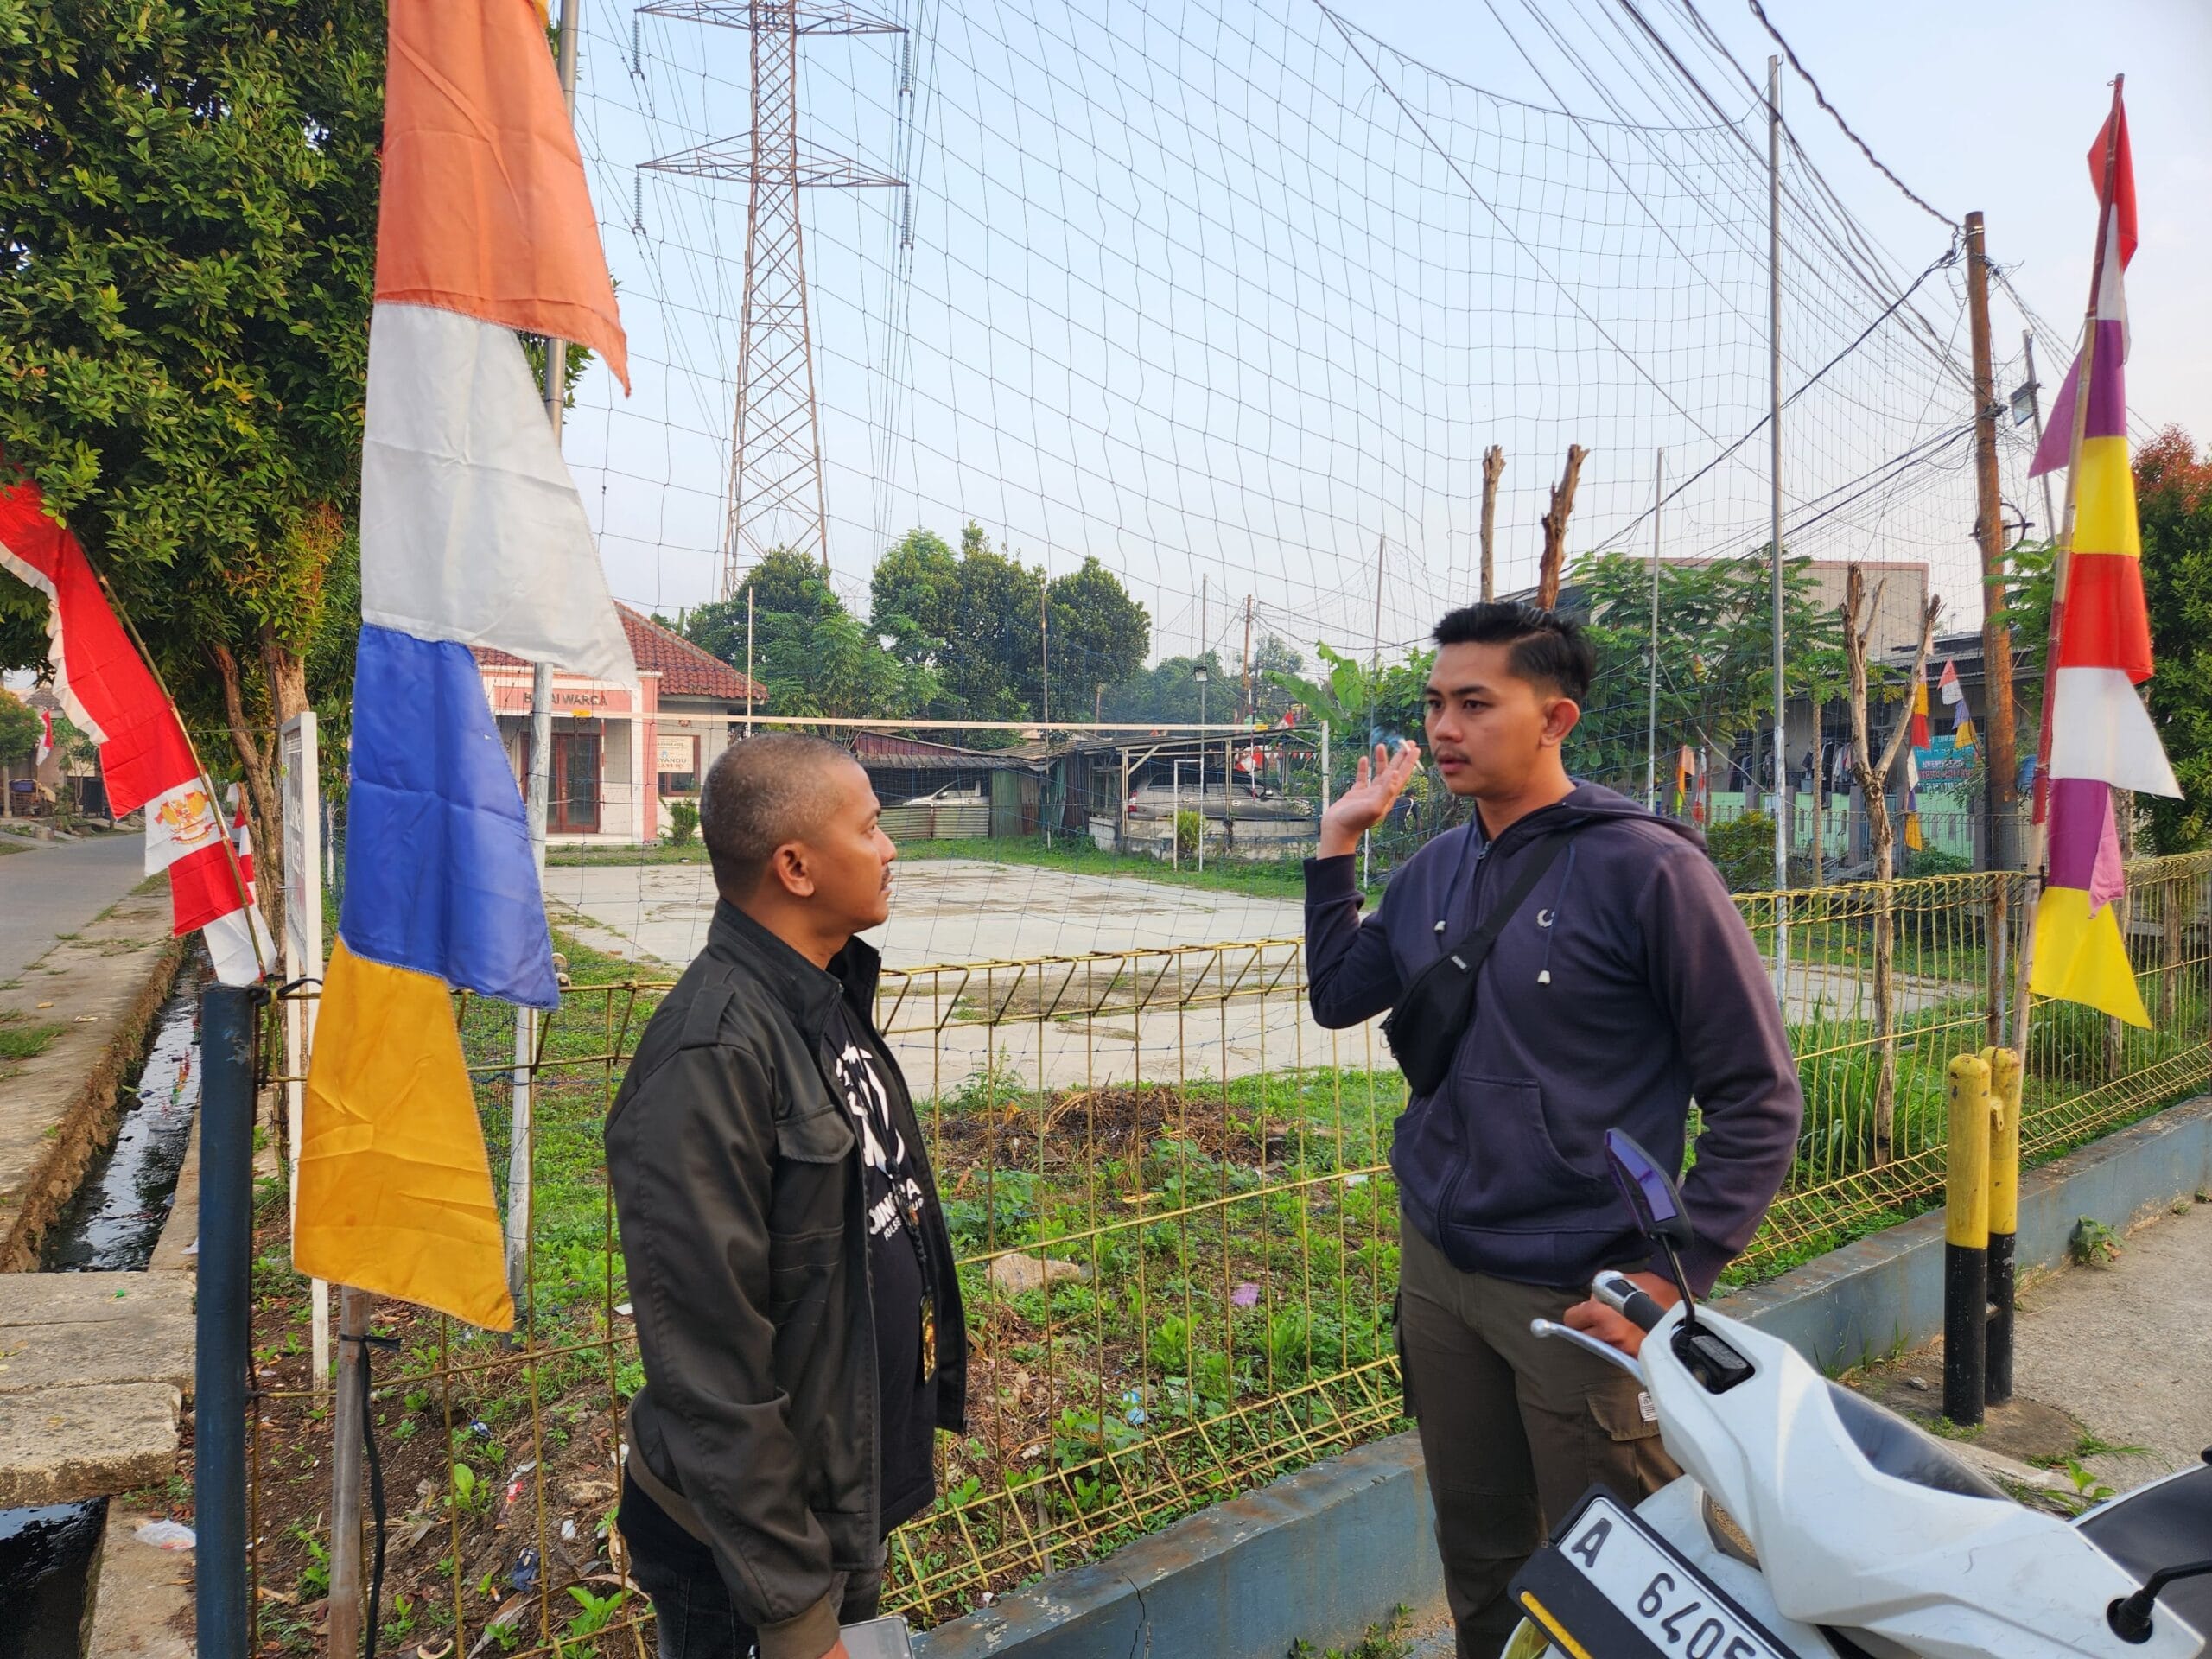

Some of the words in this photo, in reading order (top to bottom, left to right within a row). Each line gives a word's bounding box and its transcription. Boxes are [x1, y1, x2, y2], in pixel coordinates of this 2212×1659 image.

[524, 693, 560, 704] BAI
[562, 694, 608, 706] WARGA
[1571, 1517, 1612, 1568] A
